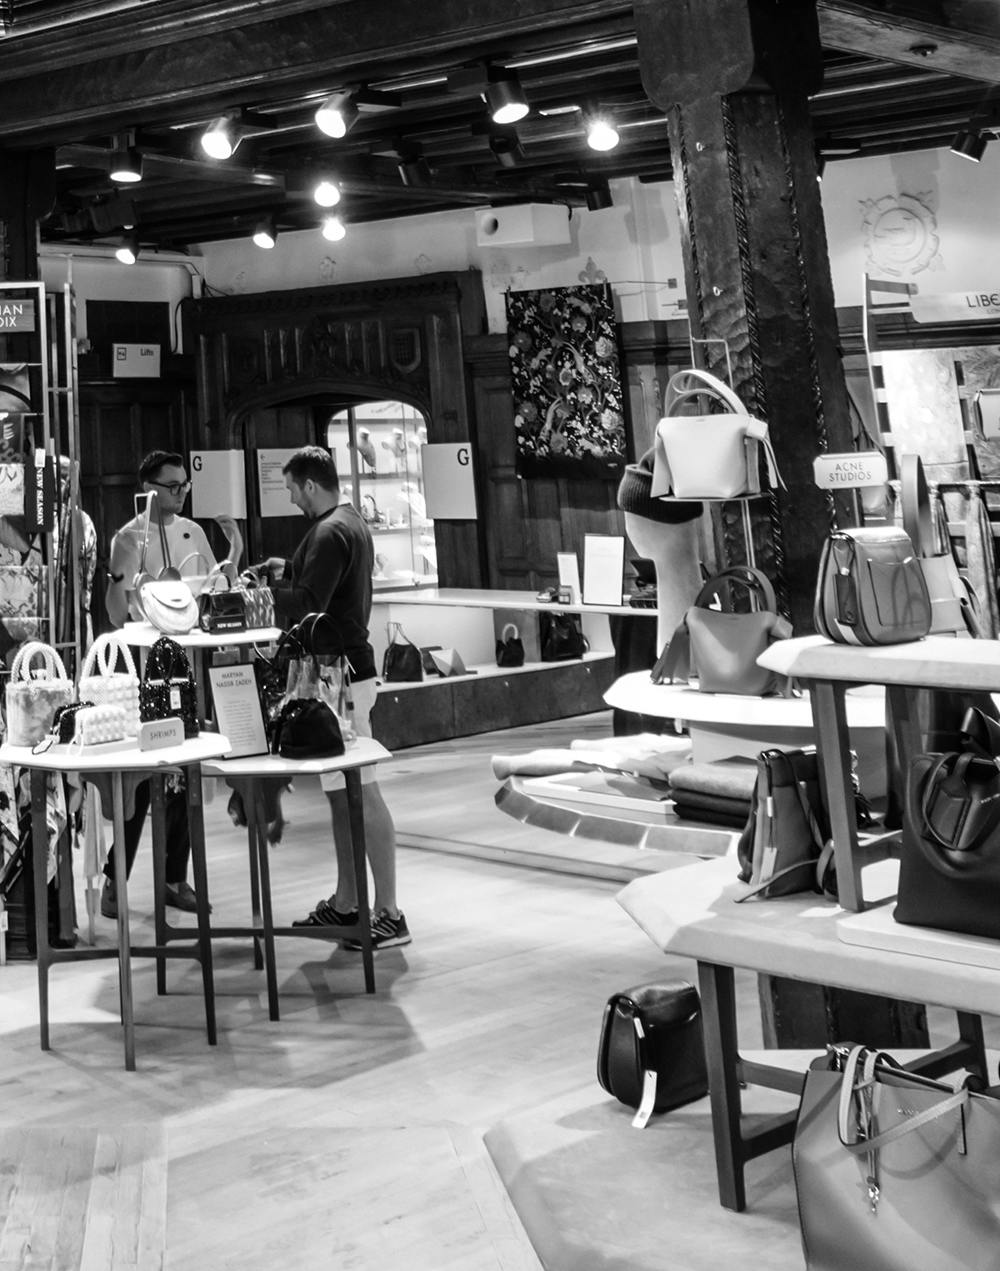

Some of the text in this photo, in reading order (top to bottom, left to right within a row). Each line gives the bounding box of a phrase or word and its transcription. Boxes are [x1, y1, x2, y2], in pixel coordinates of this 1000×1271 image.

[192, 455, 203, 472] G
[457, 448, 469, 466] G
[835, 461, 864, 472] ACNE
[828, 471, 872, 482] STUDIOS
[36, 467, 44, 525] NEW SEASON
[150, 729, 176, 740] SHRIMPS
